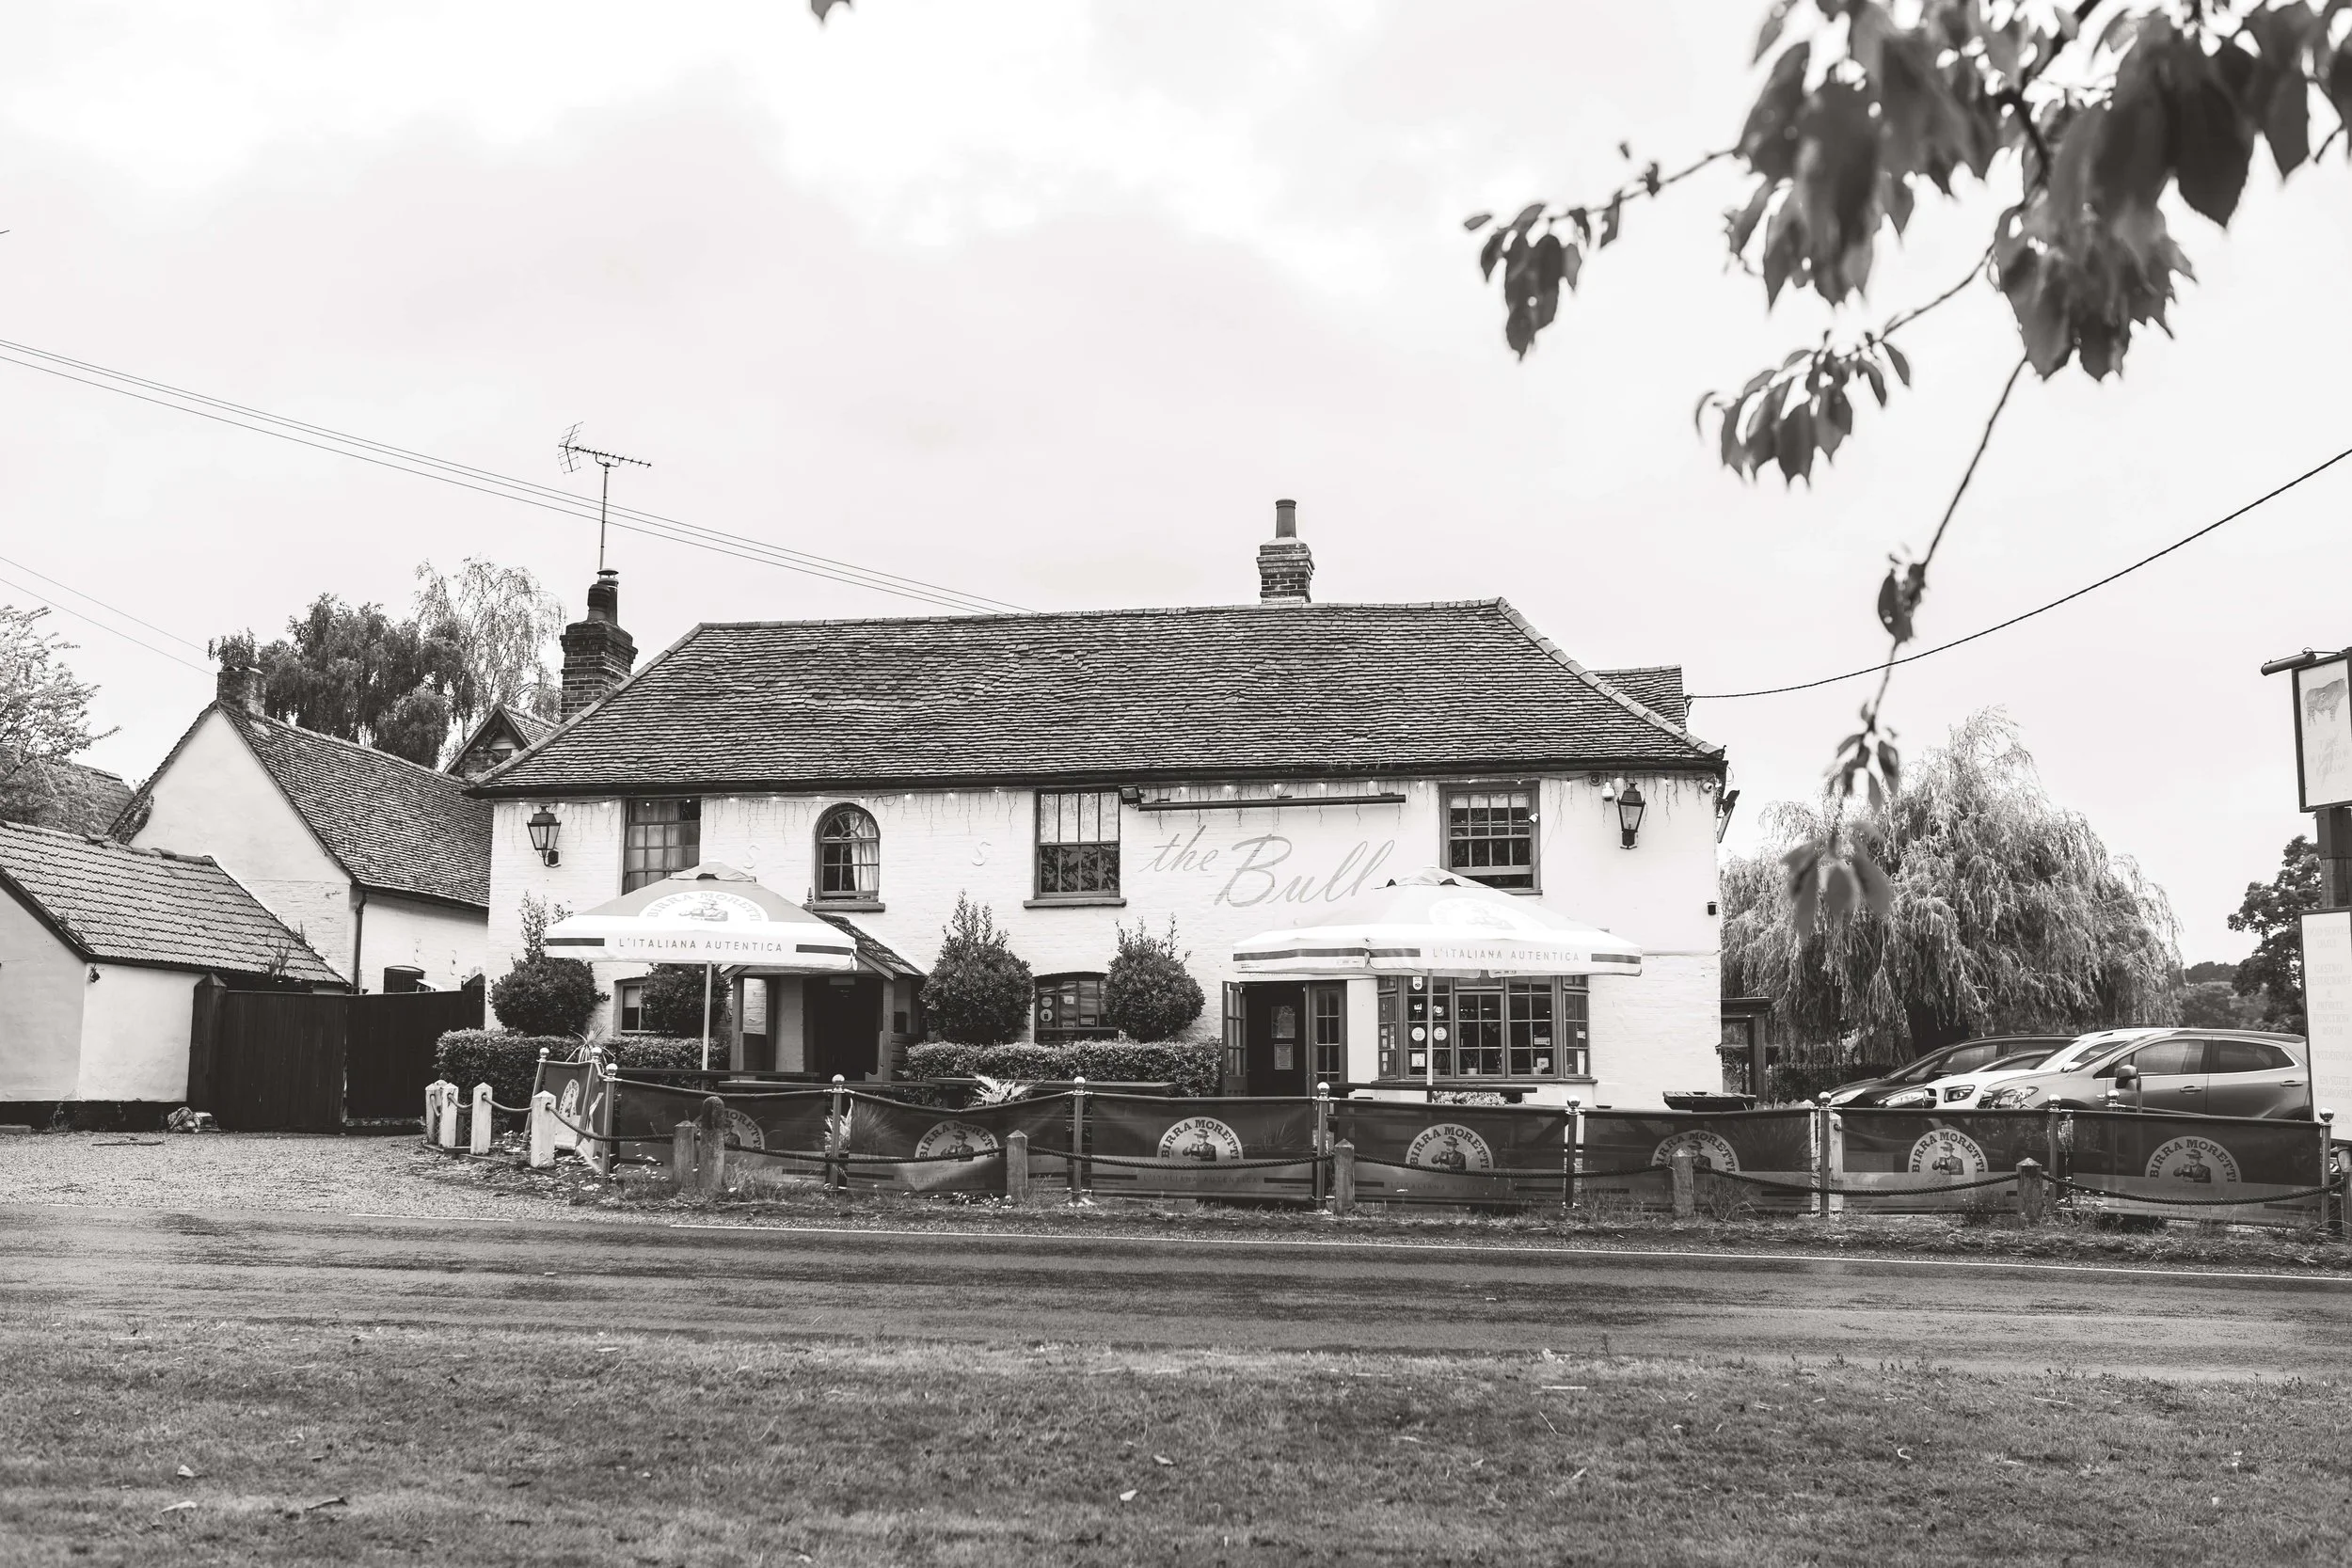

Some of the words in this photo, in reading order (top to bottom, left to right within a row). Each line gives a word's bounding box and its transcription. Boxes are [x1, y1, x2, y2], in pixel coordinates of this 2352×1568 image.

[1137, 825, 1218, 873] the
[1214, 833, 1396, 908] Bull
[647, 895, 694, 918] BIRRA
[700, 893, 762, 922] MORETTI
[619, 938, 696, 949] L'ITALIANA
[705, 941, 782, 952] AUTENTICA
[1433, 948, 1502, 959] L'ITALIANA
[1510, 950, 1580, 961] AUTENTICA
[919, 1124, 950, 1158] BIRRA
[953, 1122, 995, 1158] MORETI
[1161, 1122, 1192, 1159] BIRRA
[1195, 1119, 1239, 1160] MORETTI
[1409, 1129, 1441, 1165] BIRRA
[1444, 1127, 1489, 1168] MORETTI
[1656, 1135, 1685, 1166] IRRA
[1689, 1132, 1736, 1172] MORETTI
[1912, 1134, 1938, 1173] BIRRA
[1939, 1132, 1985, 1173] MORETTI
[2150, 1141, 2184, 1179] BIRRA
[2185, 1139, 2237, 1182] MORETTI
